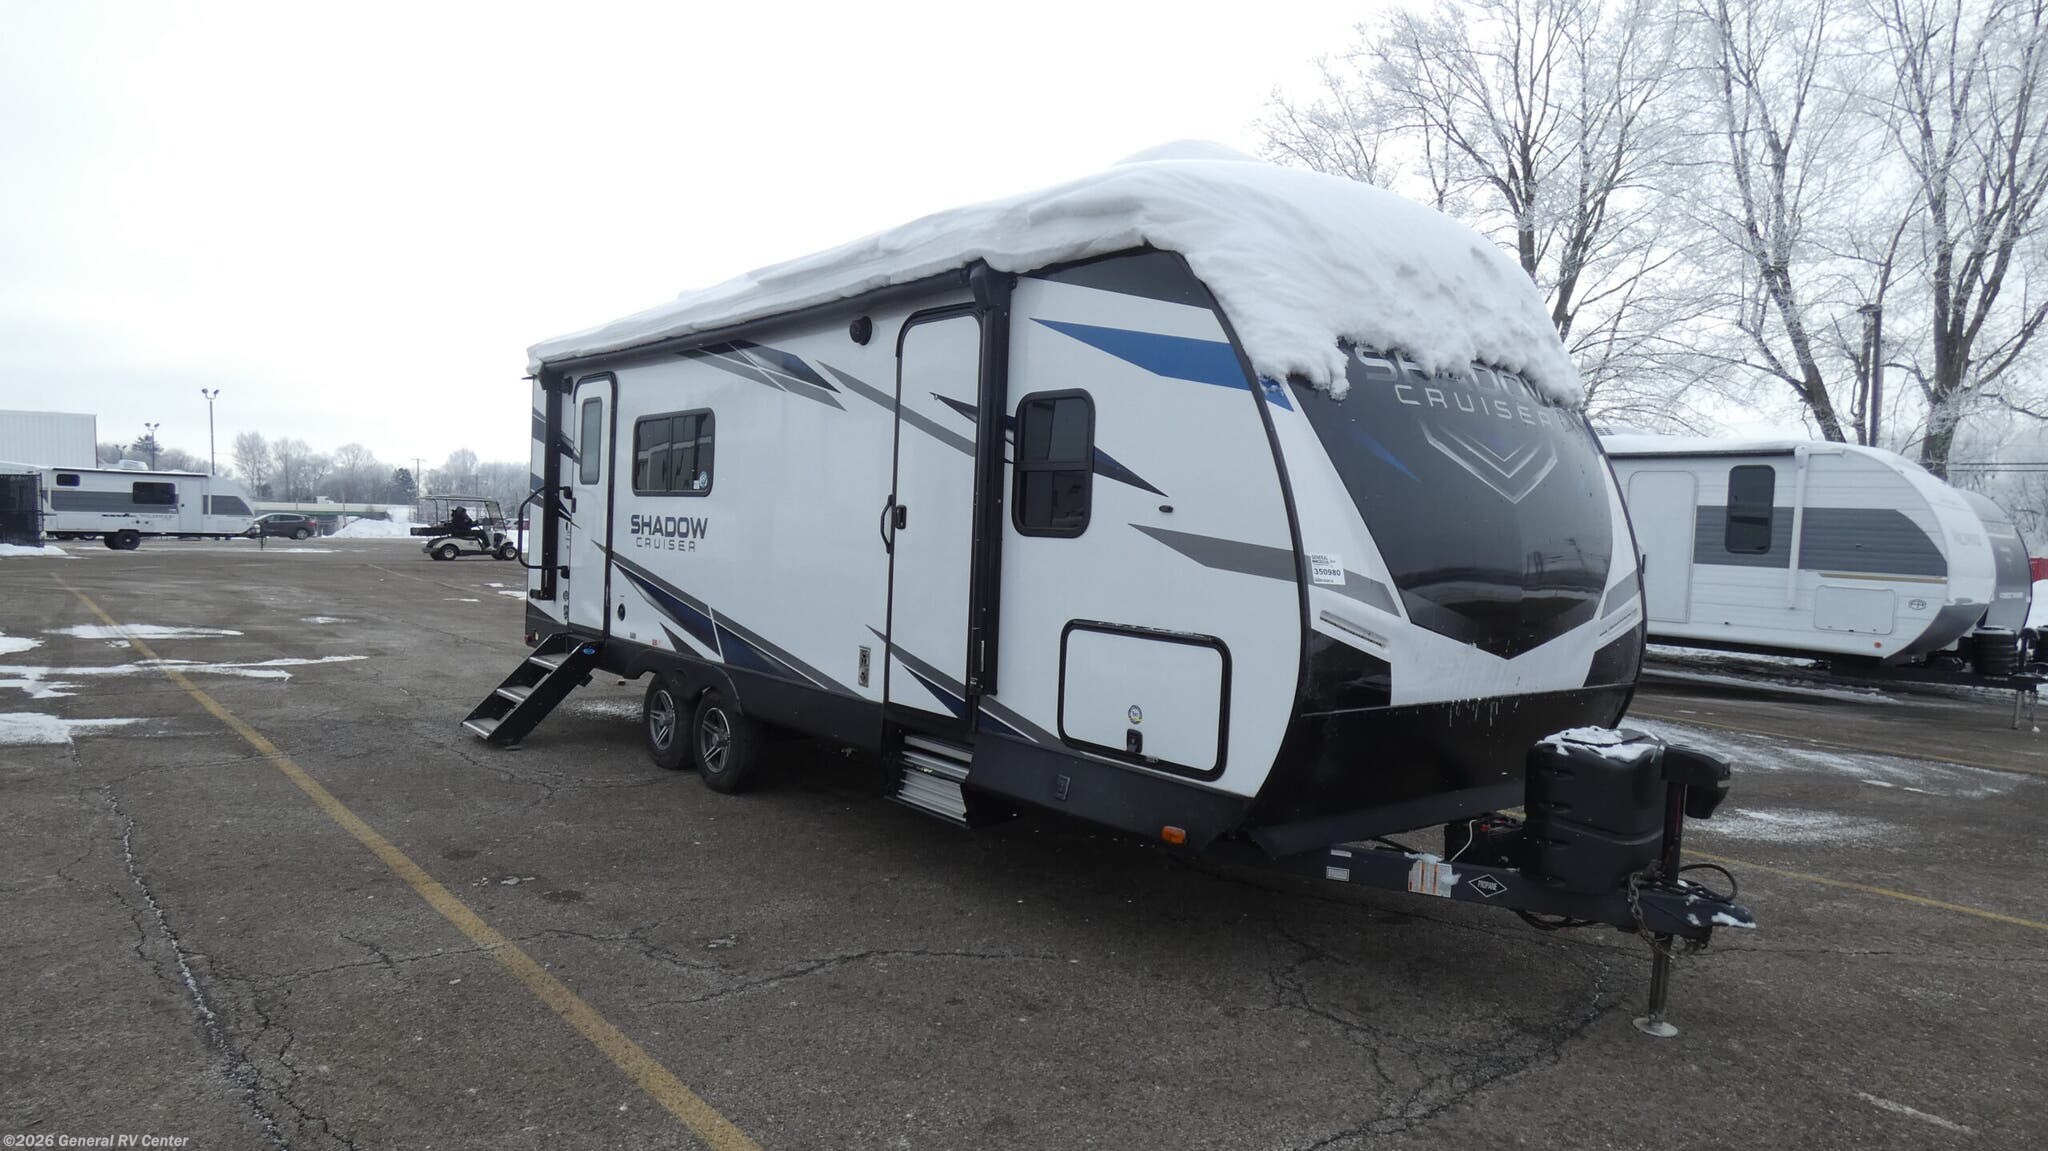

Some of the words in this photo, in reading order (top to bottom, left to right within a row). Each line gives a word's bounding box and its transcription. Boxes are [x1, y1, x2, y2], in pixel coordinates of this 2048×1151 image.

[1395, 384, 1553, 427] CRUISER
[630, 514, 708, 539] SHADOW
[636, 536, 696, 552] CRUISER
[1477, 880, 1498, 891] PROPANE
